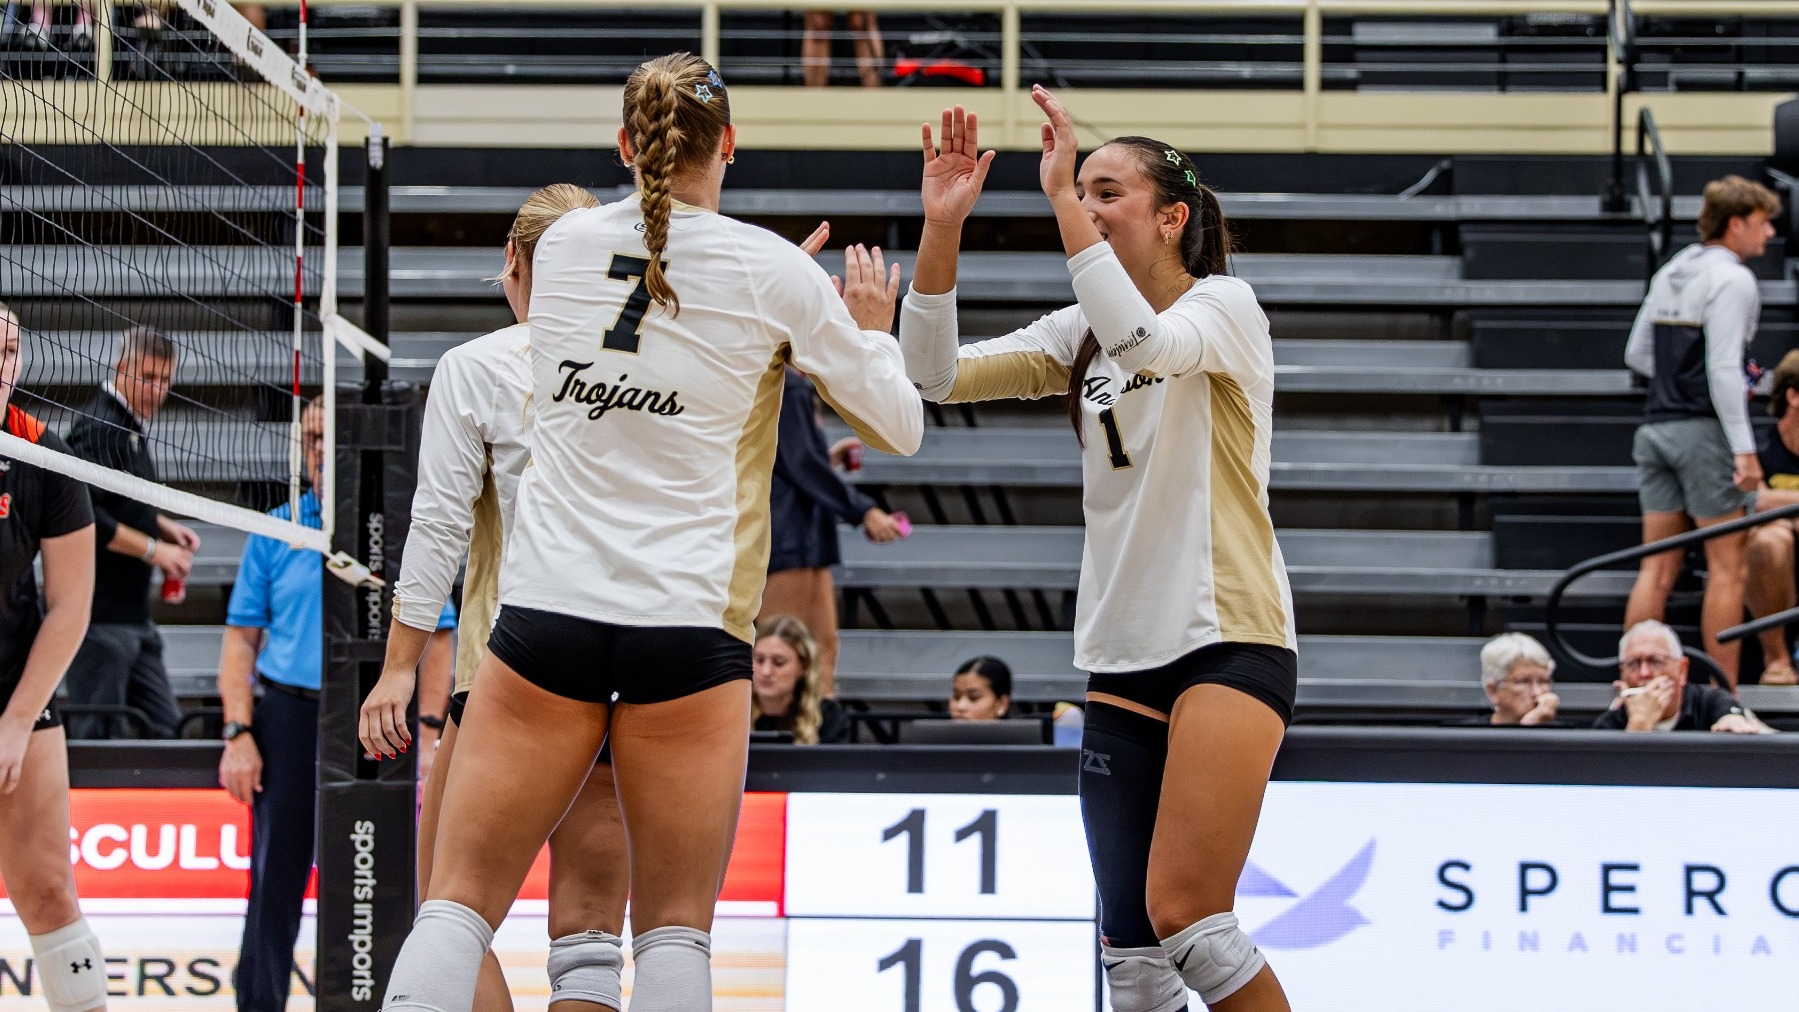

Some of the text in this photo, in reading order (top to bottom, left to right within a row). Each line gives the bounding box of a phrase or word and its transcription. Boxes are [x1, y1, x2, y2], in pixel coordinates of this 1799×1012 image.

[600, 250, 670, 356] 7
[552, 359, 685, 420] Trojans
[1098, 406, 1133, 470] 1
[366, 512, 385, 572] sports
[877, 808, 999, 895] 11
[347, 820, 377, 1002] sports imports
[1437, 929, 1772, 956] FINANCIA
[878, 938, 1020, 1012] 16
